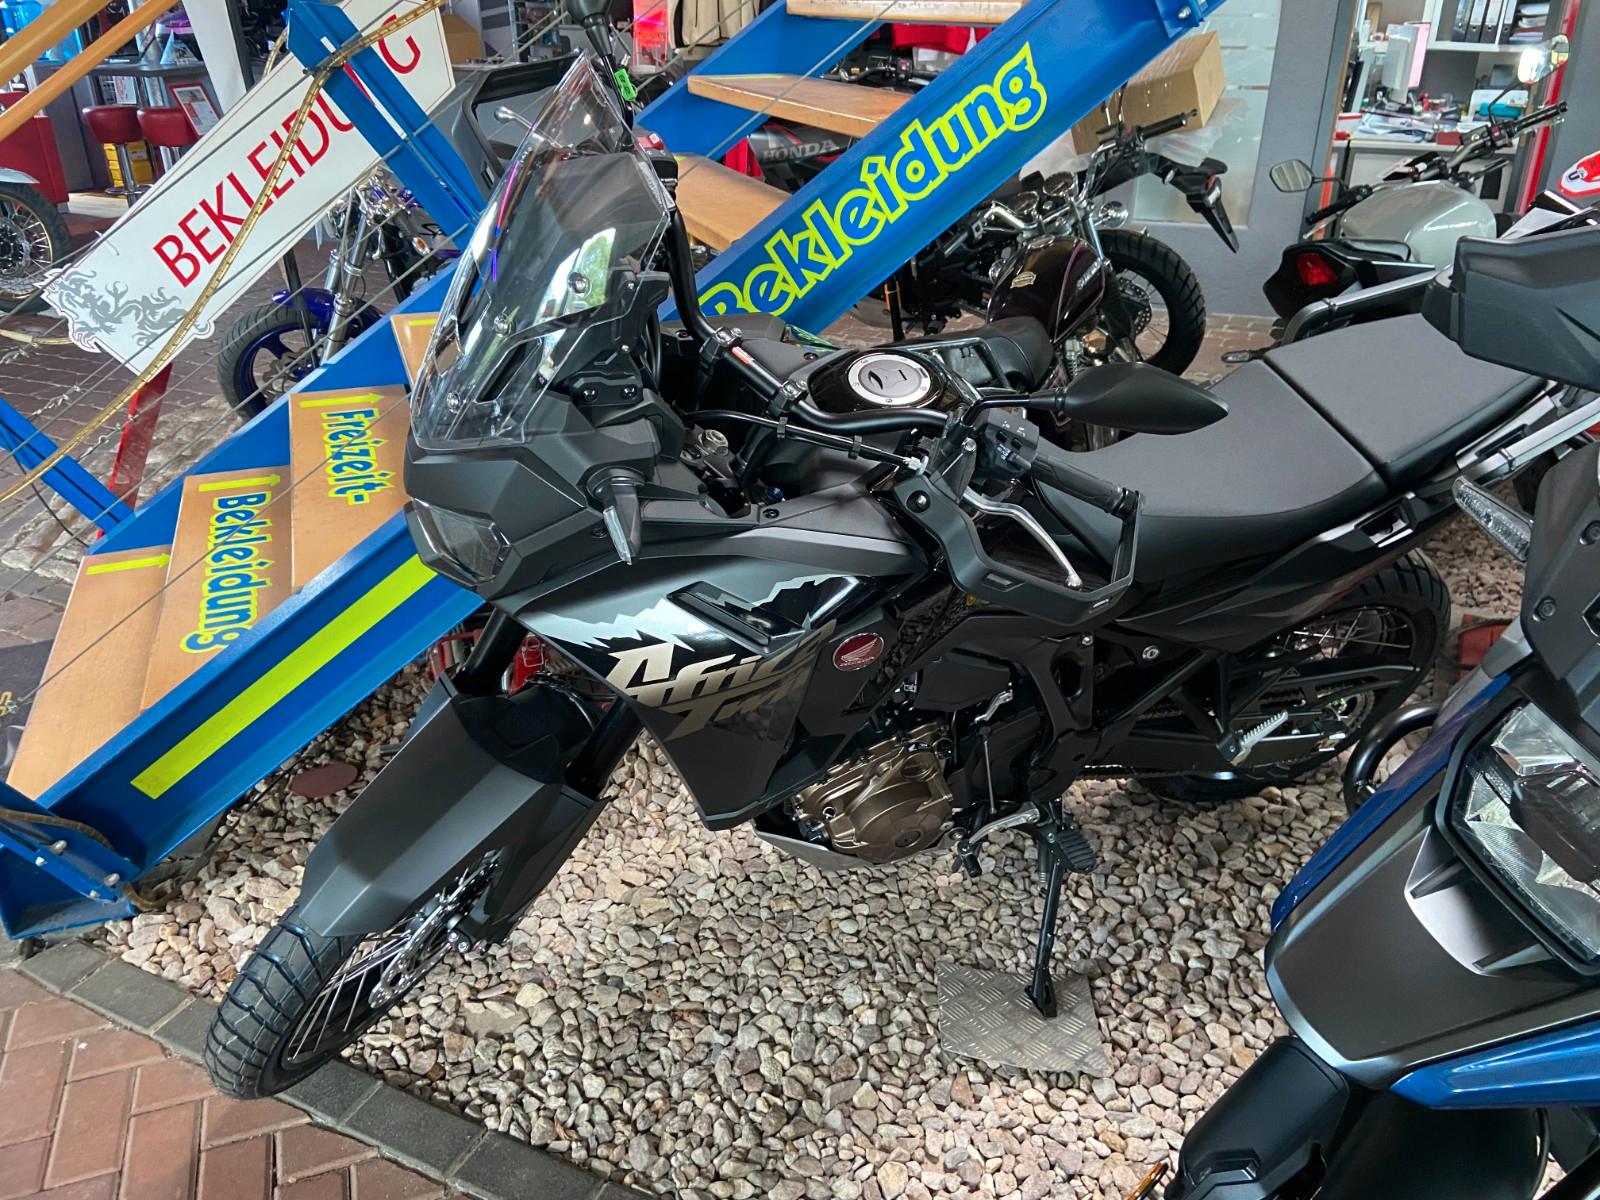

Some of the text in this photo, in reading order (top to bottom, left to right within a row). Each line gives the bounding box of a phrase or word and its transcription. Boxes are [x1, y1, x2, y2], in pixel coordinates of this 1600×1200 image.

[698, 41, 1047, 317] Bekleidung
[763, 139, 840, 161] HONDA
[320, 407, 396, 505] Freizeit-
[179, 491, 275, 653] Bekleidung
